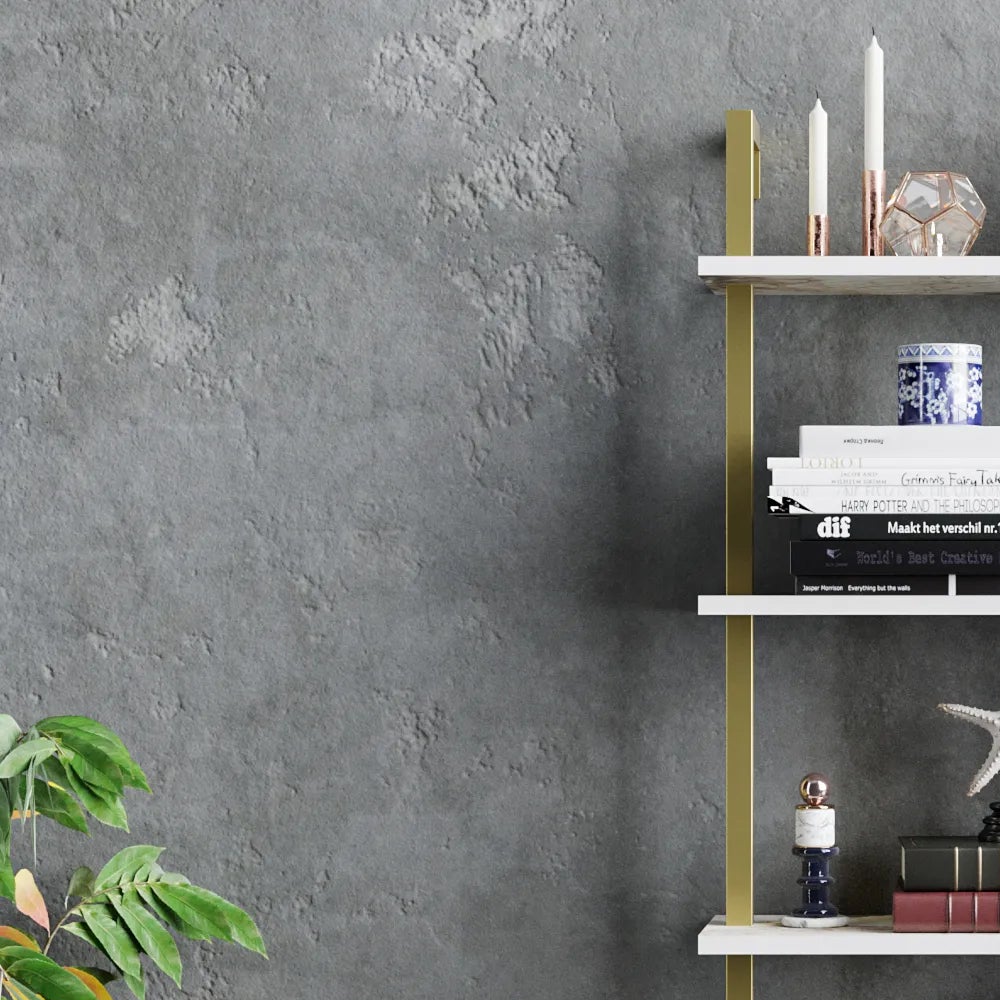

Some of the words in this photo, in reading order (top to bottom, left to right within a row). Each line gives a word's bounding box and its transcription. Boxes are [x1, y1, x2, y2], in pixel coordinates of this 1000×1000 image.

[949, 472, 976, 487] Fairy
[842, 500, 869, 513] HARRY
[873, 500, 908, 513] POTTER
[911, 500, 931, 513] AND
[934, 500, 950, 513] THE
[816, 516, 851, 539] dif
[888, 521, 920, 534] Maakt
[923, 521, 939, 534] het
[942, 521, 981, 534] verschil
[856, 551, 902, 564] World's
[908, 551, 935, 564] Best
[940, 551, 993, 564] Creative
